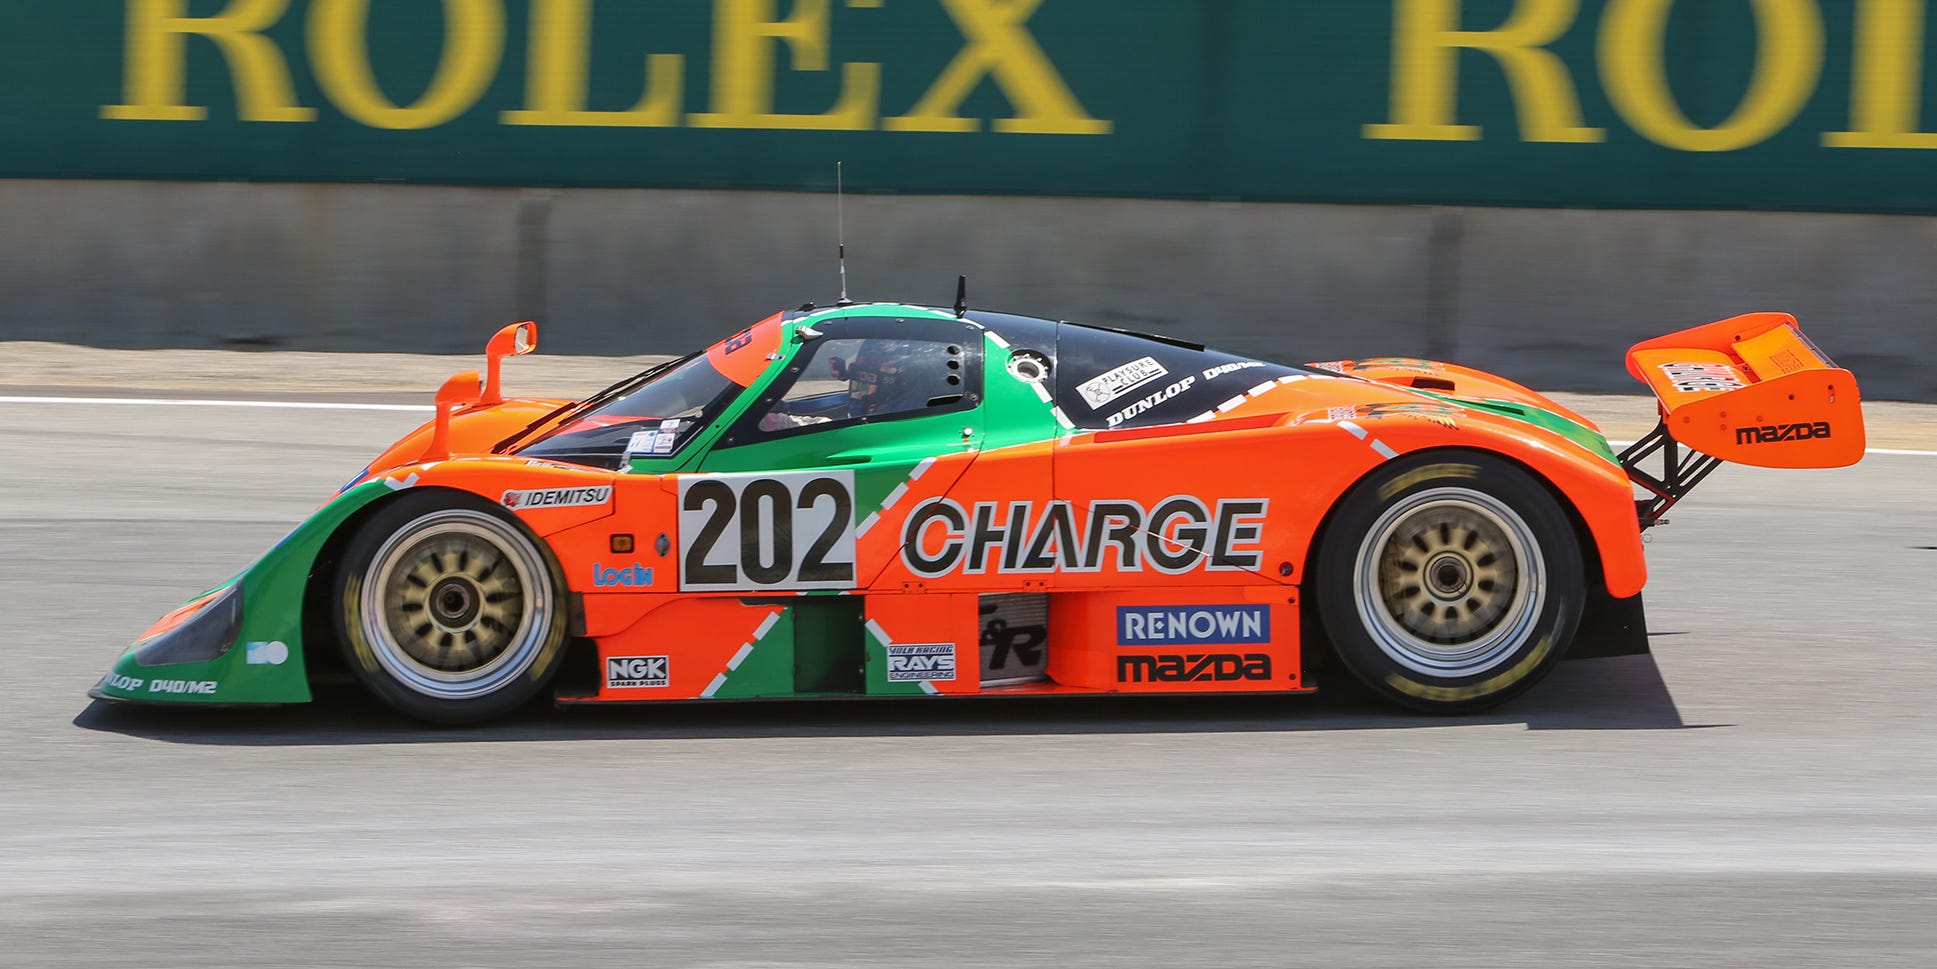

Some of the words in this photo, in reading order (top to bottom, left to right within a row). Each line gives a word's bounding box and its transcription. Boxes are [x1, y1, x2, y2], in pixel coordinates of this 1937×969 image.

[98, 0, 1113, 134] ROLEX
[1120, 371, 1148, 386] CLUB
[1106, 375, 1196, 427] DUNLOP
[1736, 421, 1831, 445] mazda
[525, 488, 610, 506] IDEMITSU
[683, 478, 854, 585] 202
[901, 495, 1269, 578] CHARGE
[1125, 611, 1261, 640] RENOWN
[610, 658, 666, 679] NGK
[889, 655, 954, 671] RAYS
[1117, 653, 1272, 683] mazda
